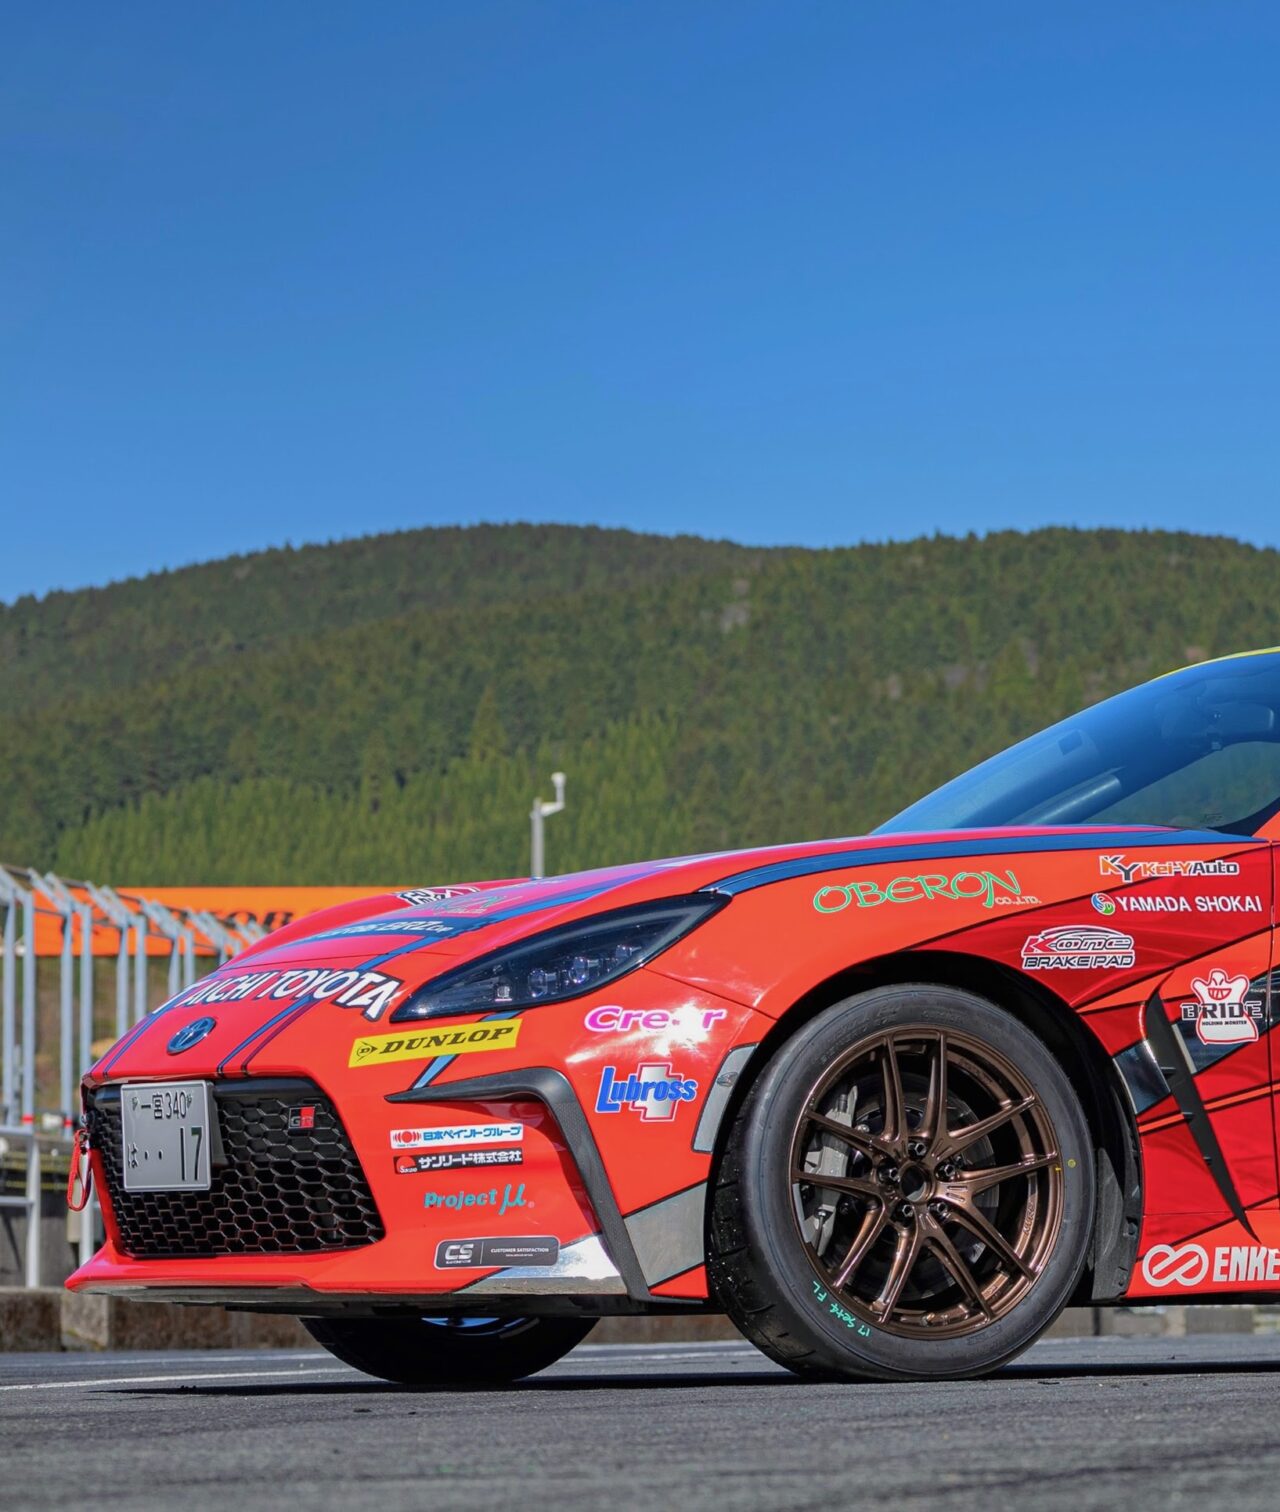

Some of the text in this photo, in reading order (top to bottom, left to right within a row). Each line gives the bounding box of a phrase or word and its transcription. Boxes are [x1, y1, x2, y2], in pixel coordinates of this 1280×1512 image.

[813, 870, 1020, 913] OBERON
[1115, 895, 1262, 912] YAMADA SHOKAI
[1024, 955, 1133, 968] BRAKE PAD
[257, 969, 402, 1019] TOYOTA
[586, 1005, 726, 1032] Crer
[1181, 1001, 1263, 1019] BRIDE
[379, 1026, 515, 1054] DUNLOP
[595, 1065, 699, 1113] Lubross
[423, 1126, 522, 1142] 日本ペイントグループ
[128, 1142, 139, 1169] は
[418, 1149, 523, 1169] サンリード株式会社
[424, 1189, 498, 1210] Project
[444, 1243, 475, 1260] CS
